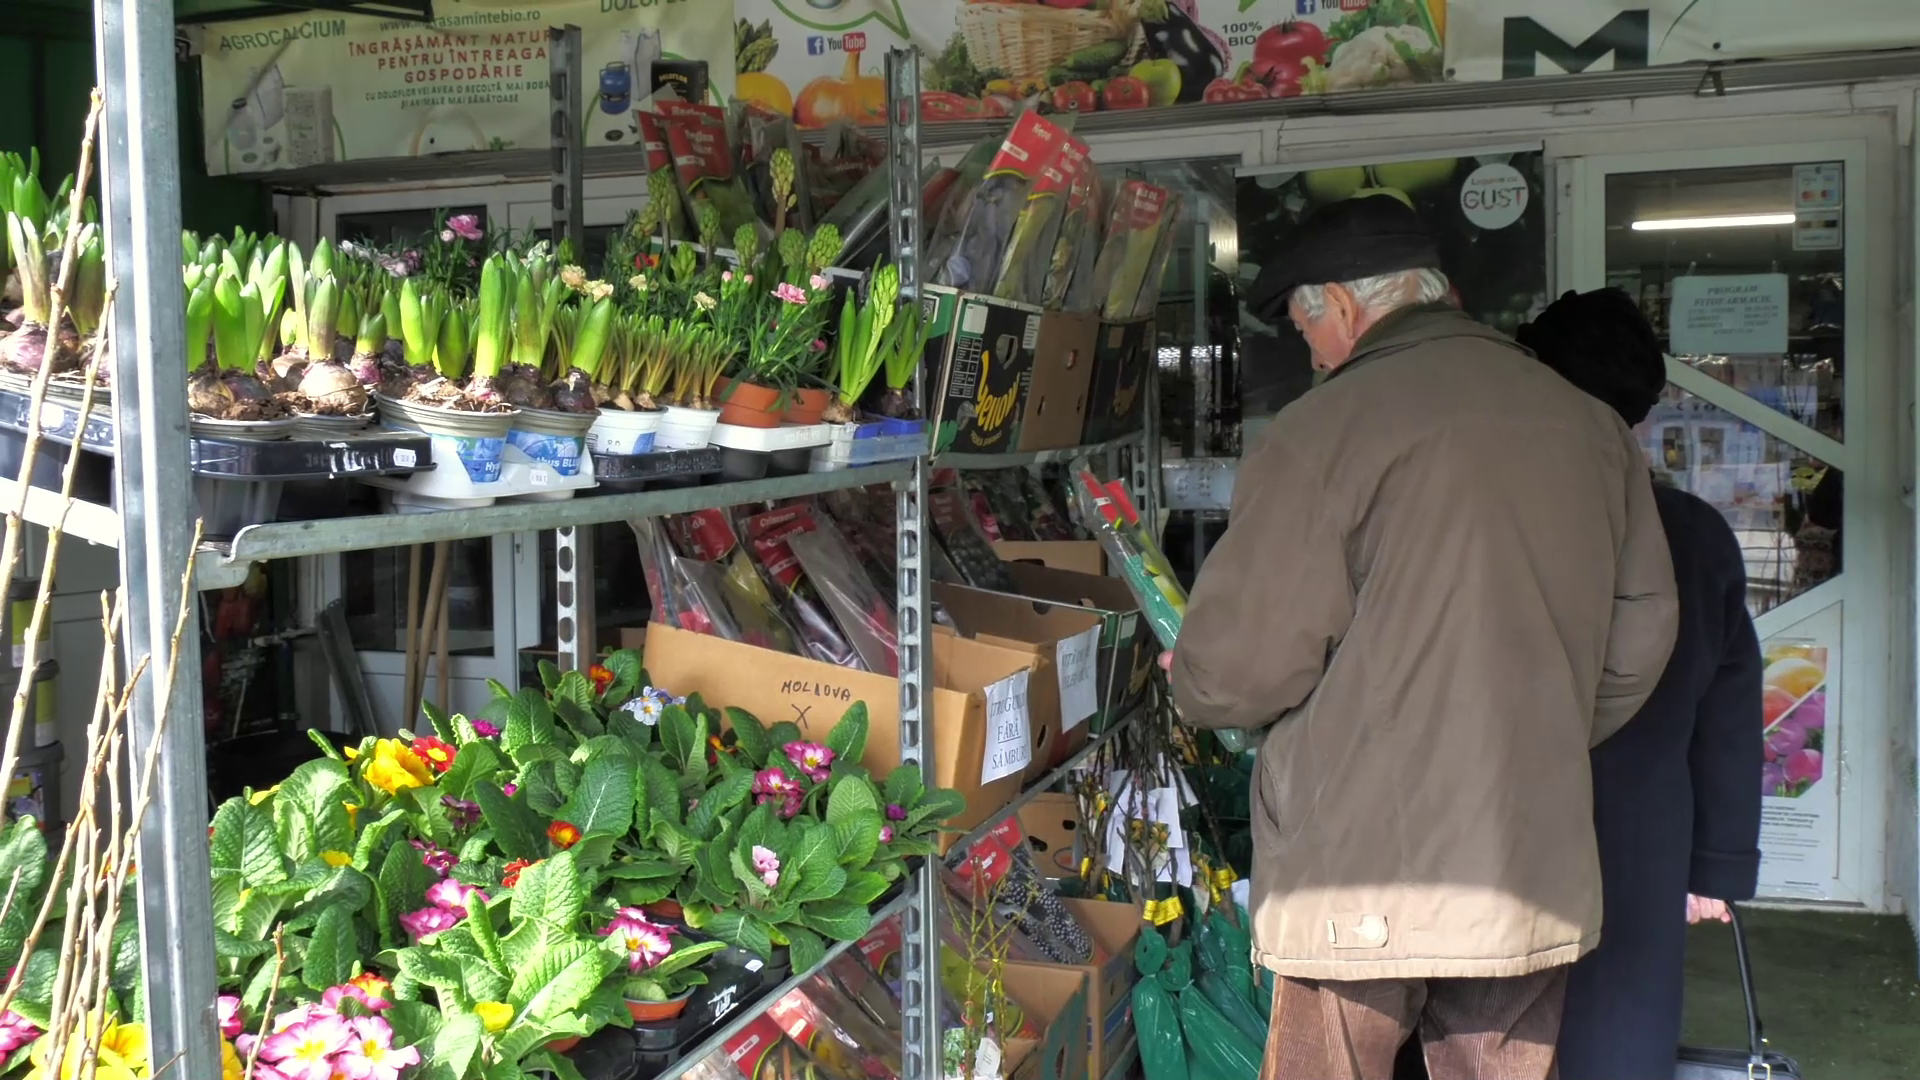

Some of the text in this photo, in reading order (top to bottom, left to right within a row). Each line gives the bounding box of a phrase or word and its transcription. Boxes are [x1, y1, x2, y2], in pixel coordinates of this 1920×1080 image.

[219, 19, 346, 51] AGROCALCIUM
[1221, 21, 1263, 34] 100%
[1228, 35, 1257, 47] BIO
[1503, 9, 1649, 79] M
[378, 47, 547, 70] PENTRU ÎNTREAGA
[404, 63, 523, 84] GOSPODĂRIE
[364, 92, 375, 101] CU
[432, 85, 454, 95] AVEA
[1463, 186, 1526, 211] GUST
